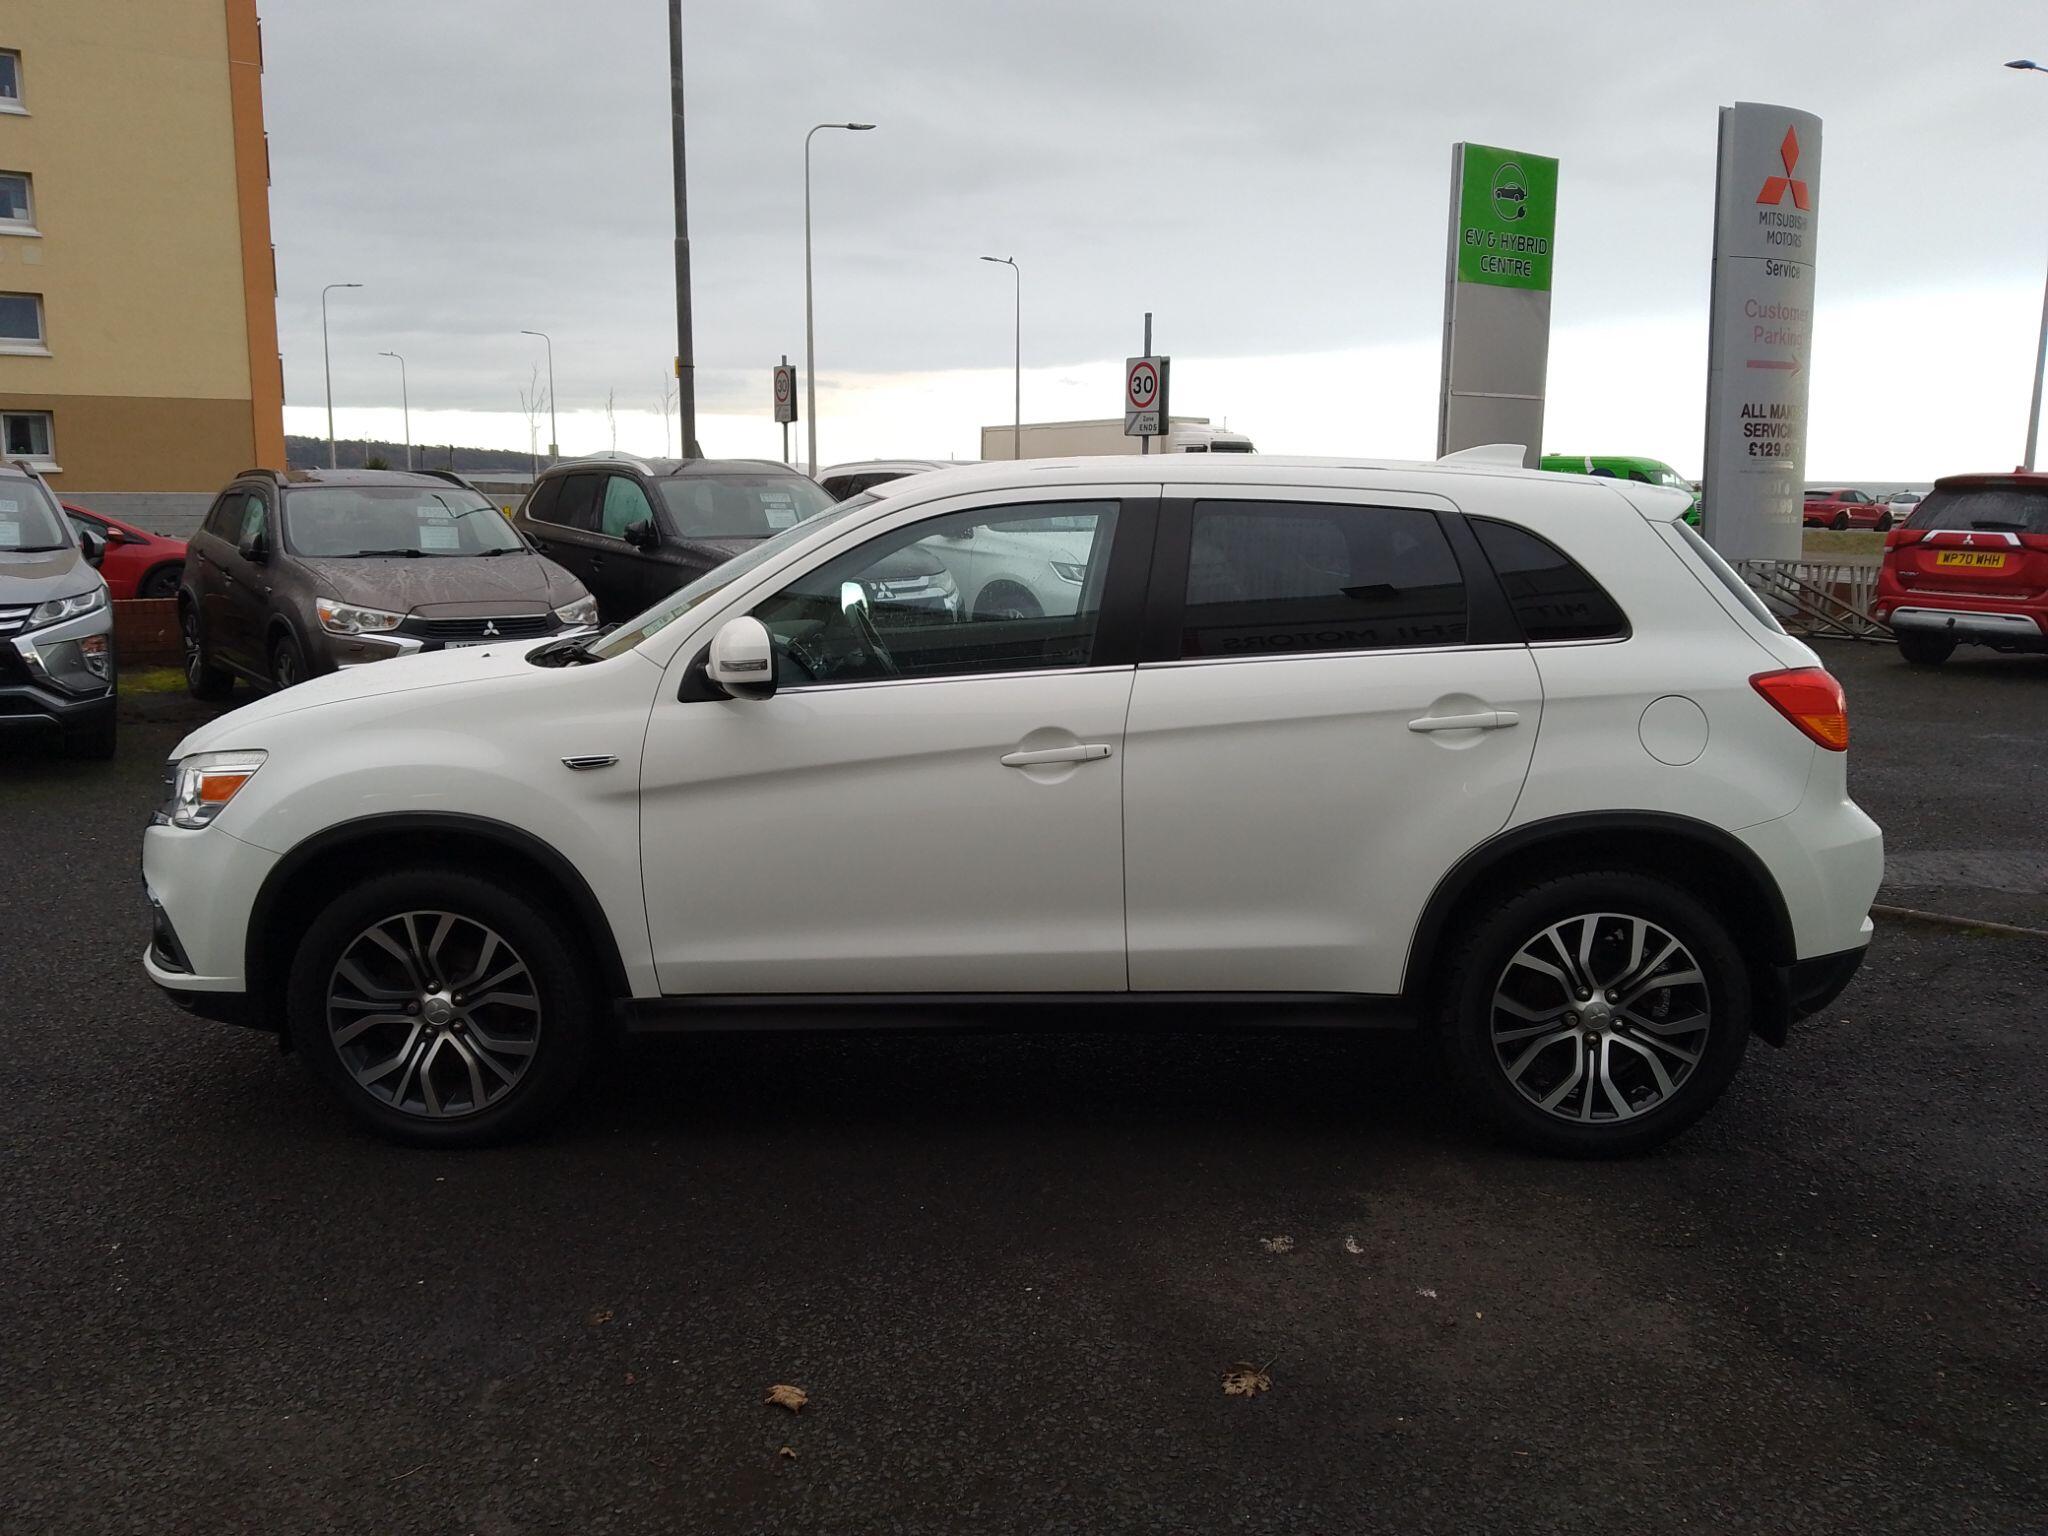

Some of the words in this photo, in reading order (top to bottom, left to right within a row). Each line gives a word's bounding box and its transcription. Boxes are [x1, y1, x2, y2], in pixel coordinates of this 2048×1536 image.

[1465, 228, 1485, 246] EV
[1487, 231, 1497, 248] &
[1500, 232, 1548, 255] HYBRID
[1766, 230, 1802, 248] MOTORS
[1480, 255, 1532, 277] CENTRE
[1766, 259, 1800, 279] Service
[1132, 376, 1154, 394] 30
[1741, 403, 1766, 418] ALL
[1139, 423, 1158, 431] ENDS
[1943, 553, 1973, 565] WP70
[1975, 553, 2001, 566] WHH
